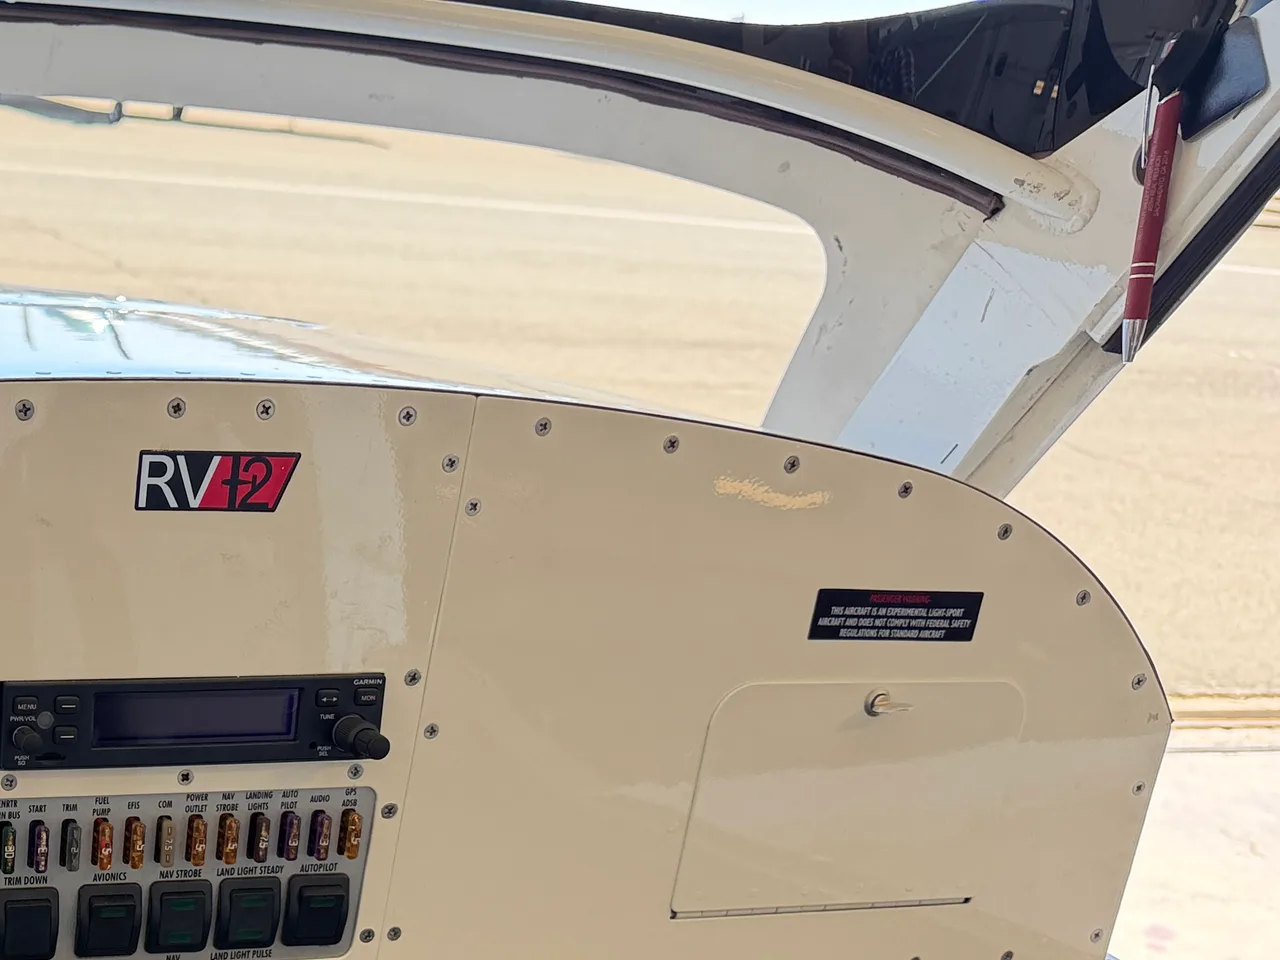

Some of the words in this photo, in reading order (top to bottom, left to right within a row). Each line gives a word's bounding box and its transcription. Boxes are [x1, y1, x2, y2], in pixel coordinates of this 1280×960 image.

[830, 606, 844, 615] THIS
[844, 607, 871, 615] AIRCRAFT
[886, 607, 927, 616] EXPERIMENTAL
[928, 608, 965, 617] LIGHT-SPORT
[818, 618, 845, 626] AIRCRAFT
[845, 618, 857, 626] AND
[858, 618, 873, 626] DOES
[874, 618, 886, 627] NOT
[886, 618, 910, 627] COMPLY
[910, 619, 926, 627] WITH
[926, 619, 949, 628] FEDERAL
[950, 620, 972, 628] SAFETY
[839, 629, 877, 637] REGULATIONS
[878, 629, 889, 637] FOR
[890, 629, 918, 638] STANDARD
[919, 630, 946, 638] AIRCRAFT
[245, 791, 273, 800] LANDING
[282, 790, 298, 798] AUTO
[345, 788, 357, 796] GPS
[95, 797, 110, 805] FUEL
[186, 793, 208, 802] POWER
[310, 795, 330, 803] AUDIO
[128, 801, 140, 809] EFIS
[216, 803, 238, 812] STROBE
[248, 802, 269, 810] LIGHTS
[280, 801, 298, 810] PILOT
[342, 799, 358, 807] ADSB
[28, 805, 47, 813] START
[62, 804, 78, 812] TRIM
[92, 808, 111, 816] PUMP
[185, 805, 208, 813] OUTLET
[8, 811, 20, 819] BUS
[216, 868, 235, 877] LAND
[237, 866, 258, 876] LIGHT
[259, 865, 284, 874] STEADY
[300, 863, 338, 873] AUTOPILOT
[93, 872, 127, 882] AVIONICS
[159, 870, 174, 879] NAV
[176, 869, 202, 878] STROBE
[4, 877, 22, 886] TRIM
[24, 876, 48, 885] DOWN
[210, 951, 229, 960] LAND
[230, 950, 251, 960] LIGHT
[252, 948, 272, 958] PULSE
